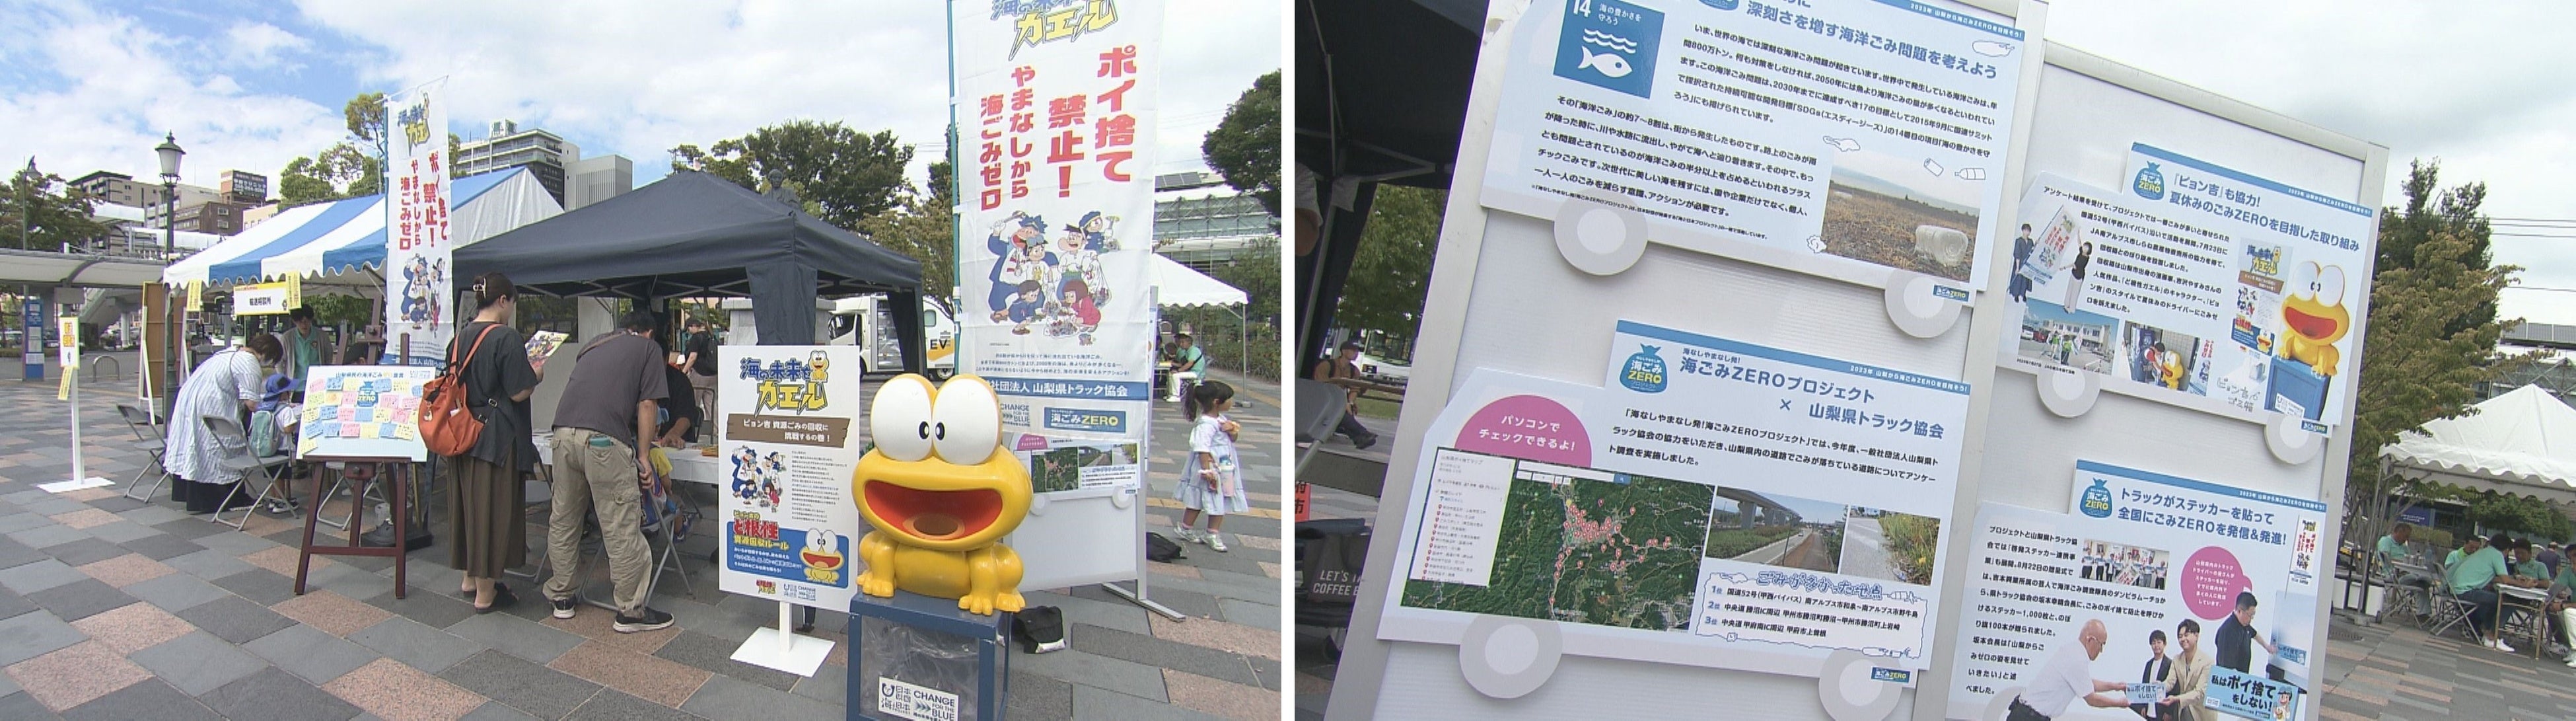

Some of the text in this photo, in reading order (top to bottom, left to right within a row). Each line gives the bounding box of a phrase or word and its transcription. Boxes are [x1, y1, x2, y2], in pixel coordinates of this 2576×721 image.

[1573, 0, 1591, 18] 14
[1599, 3, 1642, 22] 海の豊かさを
[1598, 13, 1618, 26] 守ろう
[1746, 1, 1997, 79] 深刻さを増す海洋ごみ問題を考えよう
[1095, 44, 1137, 182] ポイ捨て
[1009, 65, 1036, 199] やまなしから
[980, 94, 1004, 211] 海ごみゼロ
[1047, 94, 1087, 198] 禁止!
[2137, 180, 2161, 194] ZERO
[400, 176, 411, 250] 海ごみゼロ
[2168, 190, 2360, 252] 夏休みのごみZEROを目指した取り組み
[930, 339, 948, 350] EV
[1682, 347, 1740, 363] 海なしやまなし発!
[739, 357, 811, 381] 海の未来を
[1631, 360, 1663, 374] 海ごみ
[1628, 370, 1663, 384] ZERO
[1679, 356, 1875, 404] 海ごみZEROプロジェクト
[754, 380, 828, 418] カエル
[1032, 382, 1128, 397] 山梨県トラック協会
[743, 418, 771, 428] ピョン吉
[1050, 412, 1120, 427] 海ごみZERO
[1501, 414, 1561, 433] パソコンで
[1808, 402, 1944, 439] 山梨県トラック協会
[1479, 429, 1575, 451] チェックできるよ!
[1609, 444, 1699, 466] ト調査を実施しました。
[1612, 426, 1936, 482] ラック協会の協力をいただき、山梨県内の道路でごみが落ちている道路についてアンケー
[2085, 500, 2109, 511] ZERO
[2087, 490, 2109, 503] 海ごみ
[2121, 487, 2275, 526] トラックがステッカーを貼って
[1989, 525, 2078, 546] プロジェクトと山梨県トラック協
[2118, 506, 2287, 546] 全国にごみZEROを発信&発進!
[1320, 570, 1349, 582] LET'S
[1312, 582, 1351, 595] COFFEE
[1724, 603, 1744, 613] 中央道
[1746, 606, 1781, 616] 勝沼IC周辺
[1721, 618, 1742, 628] 中央道
[1743, 621, 1784, 632] 甲府南IC周辺
[1970, 652, 2030, 665] みゼロの姿を見せて
[1966, 685, 1995, 695] べました。
[2211, 674, 2277, 700] 私はポイ捨て
[913, 690, 955, 708] CHANGE
[2232, 693, 2273, 712] をしない!
[931, 709, 955, 721] BLUE
